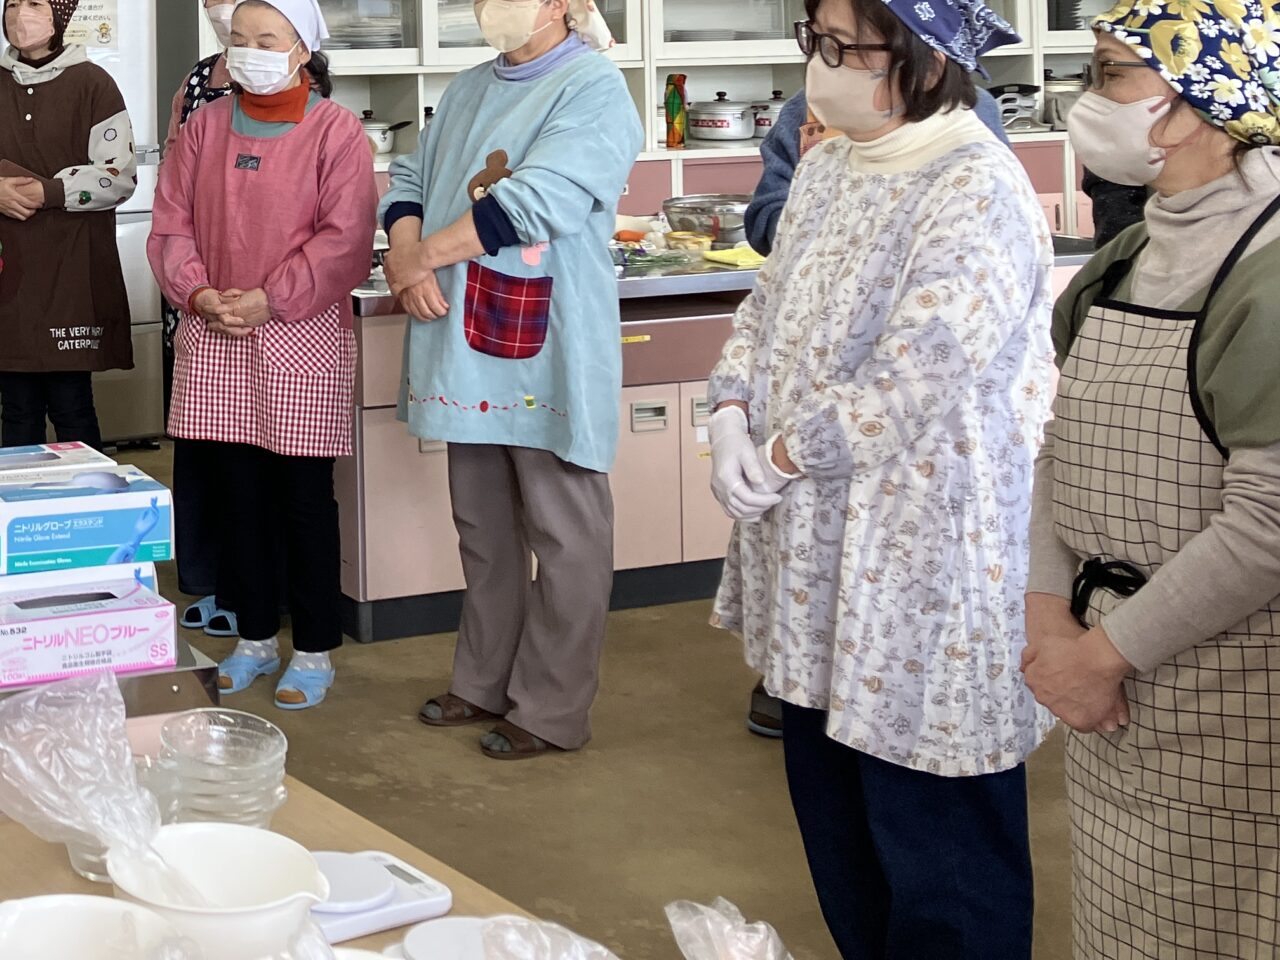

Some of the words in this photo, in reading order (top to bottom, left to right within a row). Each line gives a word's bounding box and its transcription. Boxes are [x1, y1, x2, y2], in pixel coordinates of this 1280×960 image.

[49, 328, 66, 337] THE
[69, 326, 90, 337] VERY
[14, 520, 72, 533] ニトリルグローブ
[22, 624, 150, 651] ニトリルNEOブルー
[150, 643, 169, 658] SS
